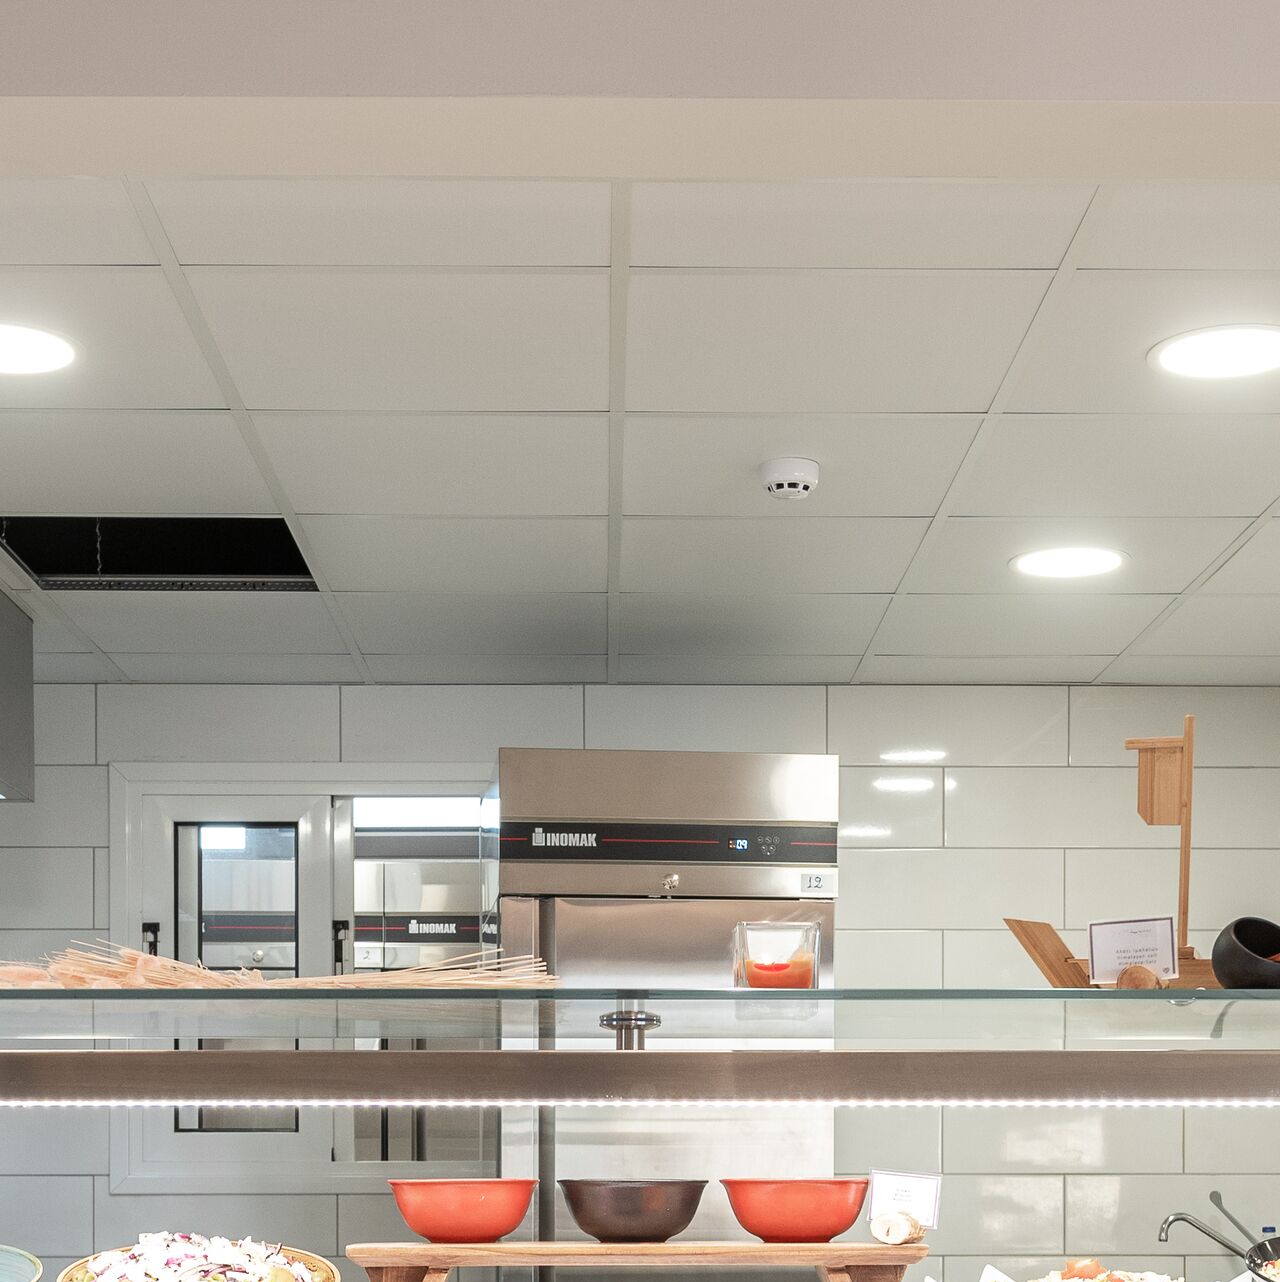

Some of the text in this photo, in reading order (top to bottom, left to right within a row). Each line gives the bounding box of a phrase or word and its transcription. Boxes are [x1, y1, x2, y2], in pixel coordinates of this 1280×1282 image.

[546, 832, 597, 847] INOMAK
[807, 876, 823, 889] 12
[420, 923, 456, 934] INOMAK
